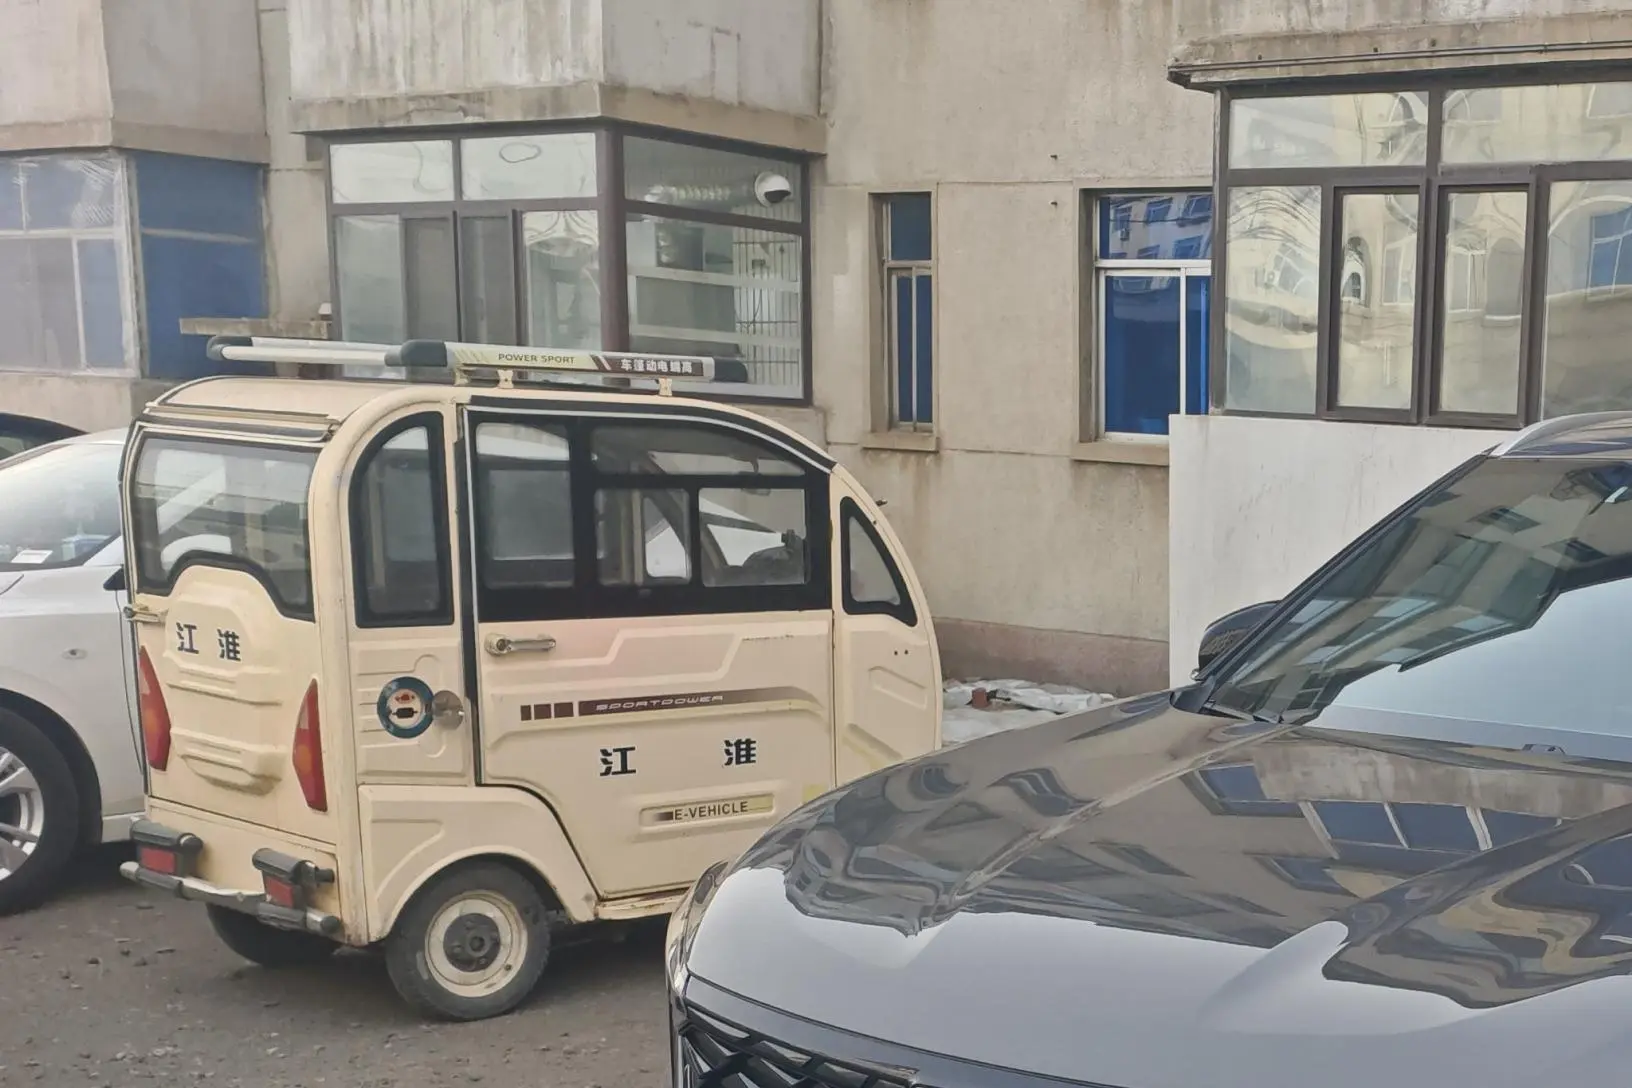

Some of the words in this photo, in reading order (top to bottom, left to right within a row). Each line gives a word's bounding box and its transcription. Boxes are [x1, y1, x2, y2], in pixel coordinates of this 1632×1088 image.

[498, 352, 538, 362] POWER
[541, 354, 575, 365] SPORT
[176, 622, 241, 662] 江淮
[674, 801, 748, 821] E-VEHICLE
